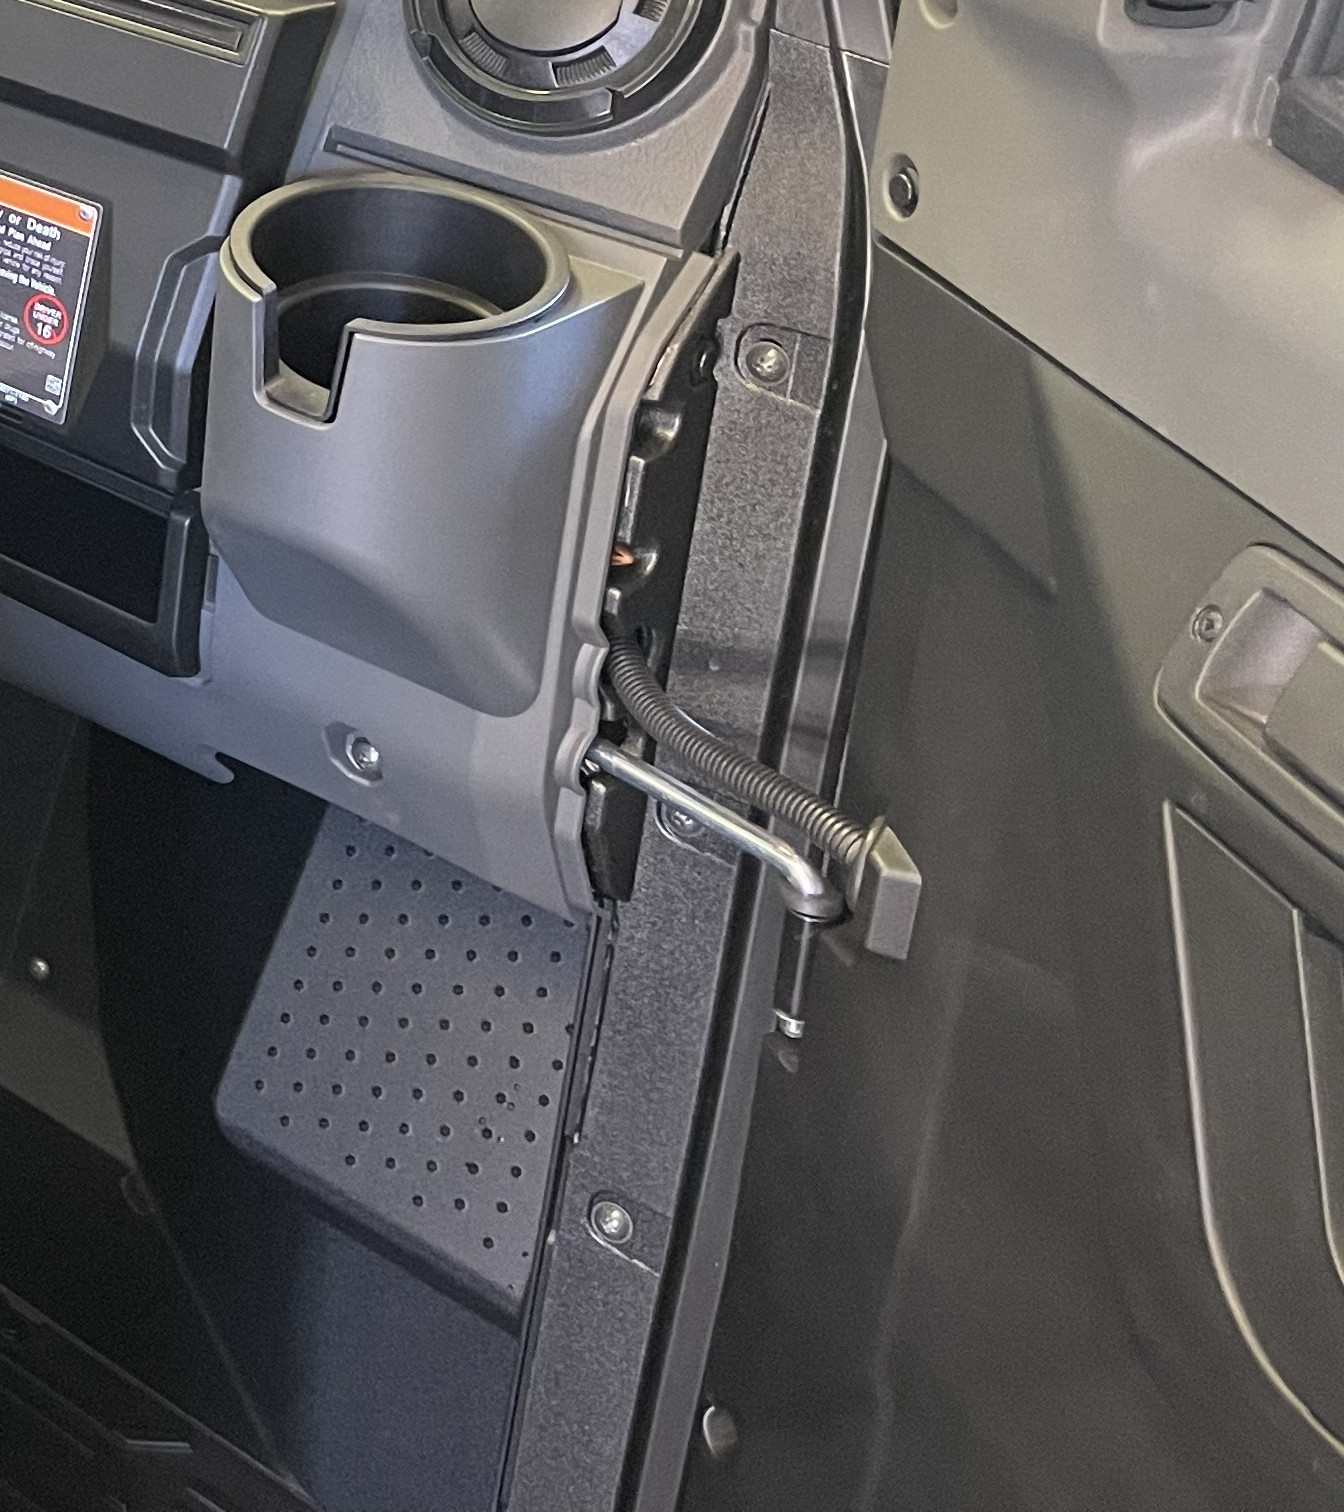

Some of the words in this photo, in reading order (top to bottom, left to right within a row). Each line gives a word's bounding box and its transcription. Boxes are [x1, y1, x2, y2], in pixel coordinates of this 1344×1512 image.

[8, 213, 22, 226] or
[26, 217, 62, 241] Death
[33, 301, 63, 320] DRIVER
[36, 321, 53, 339] 16
